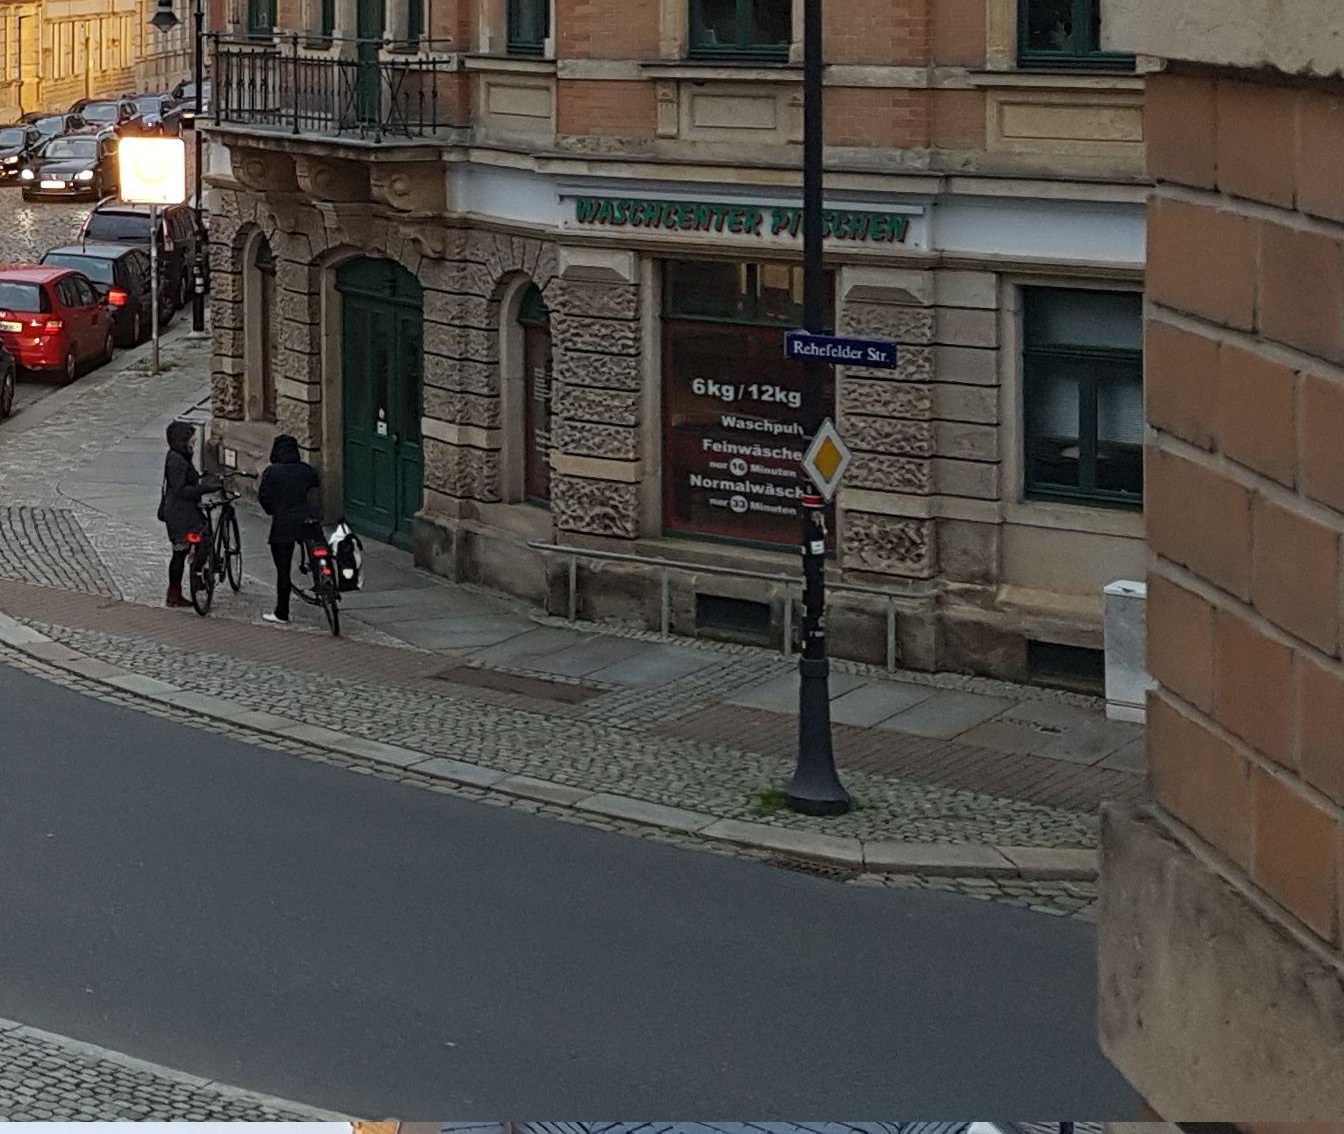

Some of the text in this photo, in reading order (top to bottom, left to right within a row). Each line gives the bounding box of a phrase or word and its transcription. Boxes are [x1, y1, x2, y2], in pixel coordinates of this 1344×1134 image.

[576, 196, 910, 244] WASCHCENTER PISCHEN
[793, 340, 890, 362] Rehefelder Str.
[702, 439, 803, 461] Feinwäsche
[750, 464, 797, 478] Minuten
[689, 474, 804, 499] Normalwäsch
[750, 501, 797, 516] Minuten
